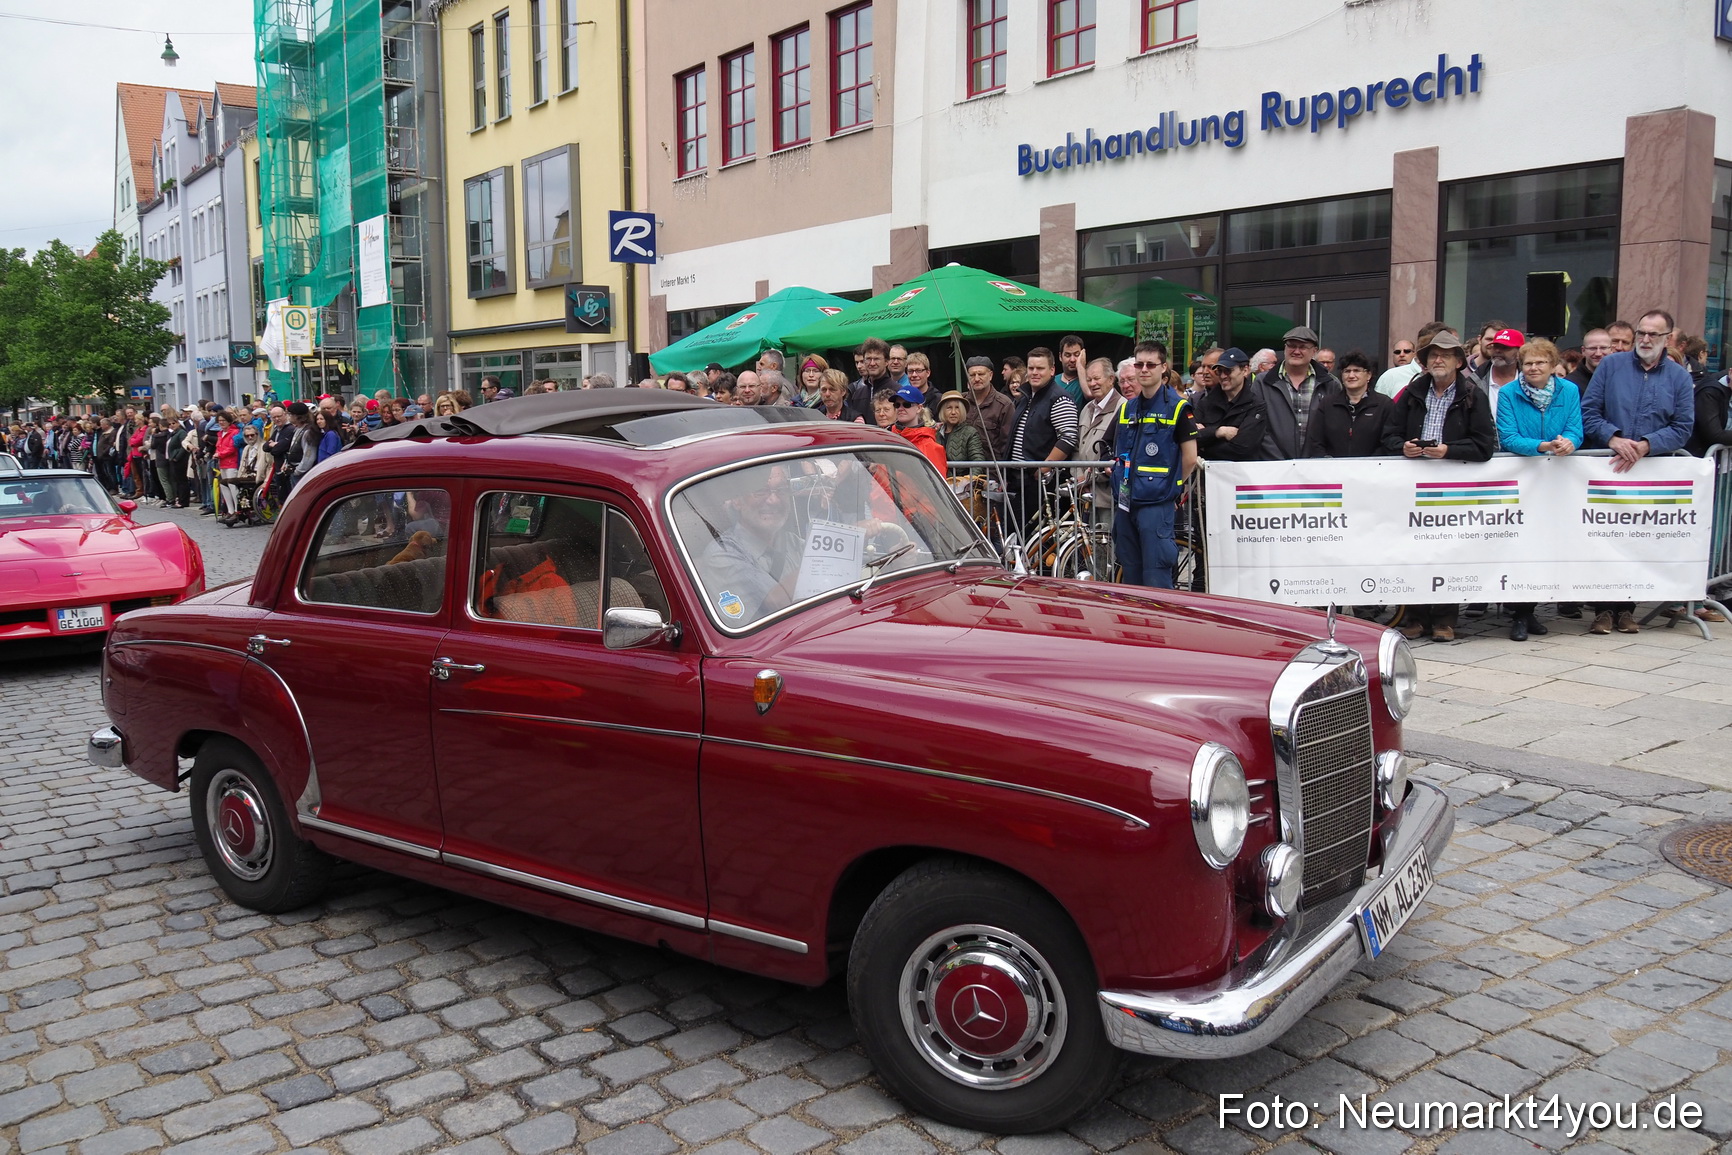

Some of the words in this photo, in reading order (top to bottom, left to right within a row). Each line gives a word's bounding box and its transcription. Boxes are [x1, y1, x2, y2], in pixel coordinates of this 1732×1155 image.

[1018, 110, 1248, 177] Buchhandlung
[1261, 53, 1485, 133] Rupprecht
[660, 277, 677, 288] Unterer
[676, 275, 690, 286] Markt
[690, 273, 696, 284] 15
[584, 298, 600, 318] G2
[998, 303, 1079, 313] Lammsbräu
[291, 314, 301, 326] H
[838, 310, 914, 327] Lammsbräu
[239, 348, 249, 359] G2
[1231, 512, 1348, 530] NeuerMarkt
[1408, 509, 1524, 527] NeuerMarkt
[1581, 508, 1697, 525] NeuerMarkt
[1236, 535, 1275, 543] einkaufen
[1279, 534, 1302, 543] leben
[1306, 534, 1344, 544] genießen
[1413, 532, 1453, 540] einkaufen
[1457, 531, 1480, 540] leben
[1484, 531, 1519, 540] genießen
[1587, 530, 1624, 538] einkaufen
[1628, 530, 1651, 538] leben
[1655, 530, 1691, 540] genießen
[811, 534, 845, 553] 596
[1283, 578, 1329, 586] Dammstraße
[1379, 577, 1406, 585] Mo.-Sa.
[1511, 583, 1560, 591] NM-Neumarkt
[1333, 587, 1348, 595] OPf.
[71, 609, 79, 618] N
[60, 619, 74, 629] GE
[76, 616, 104, 628] 100H
[1371, 895, 1394, 944] NM
